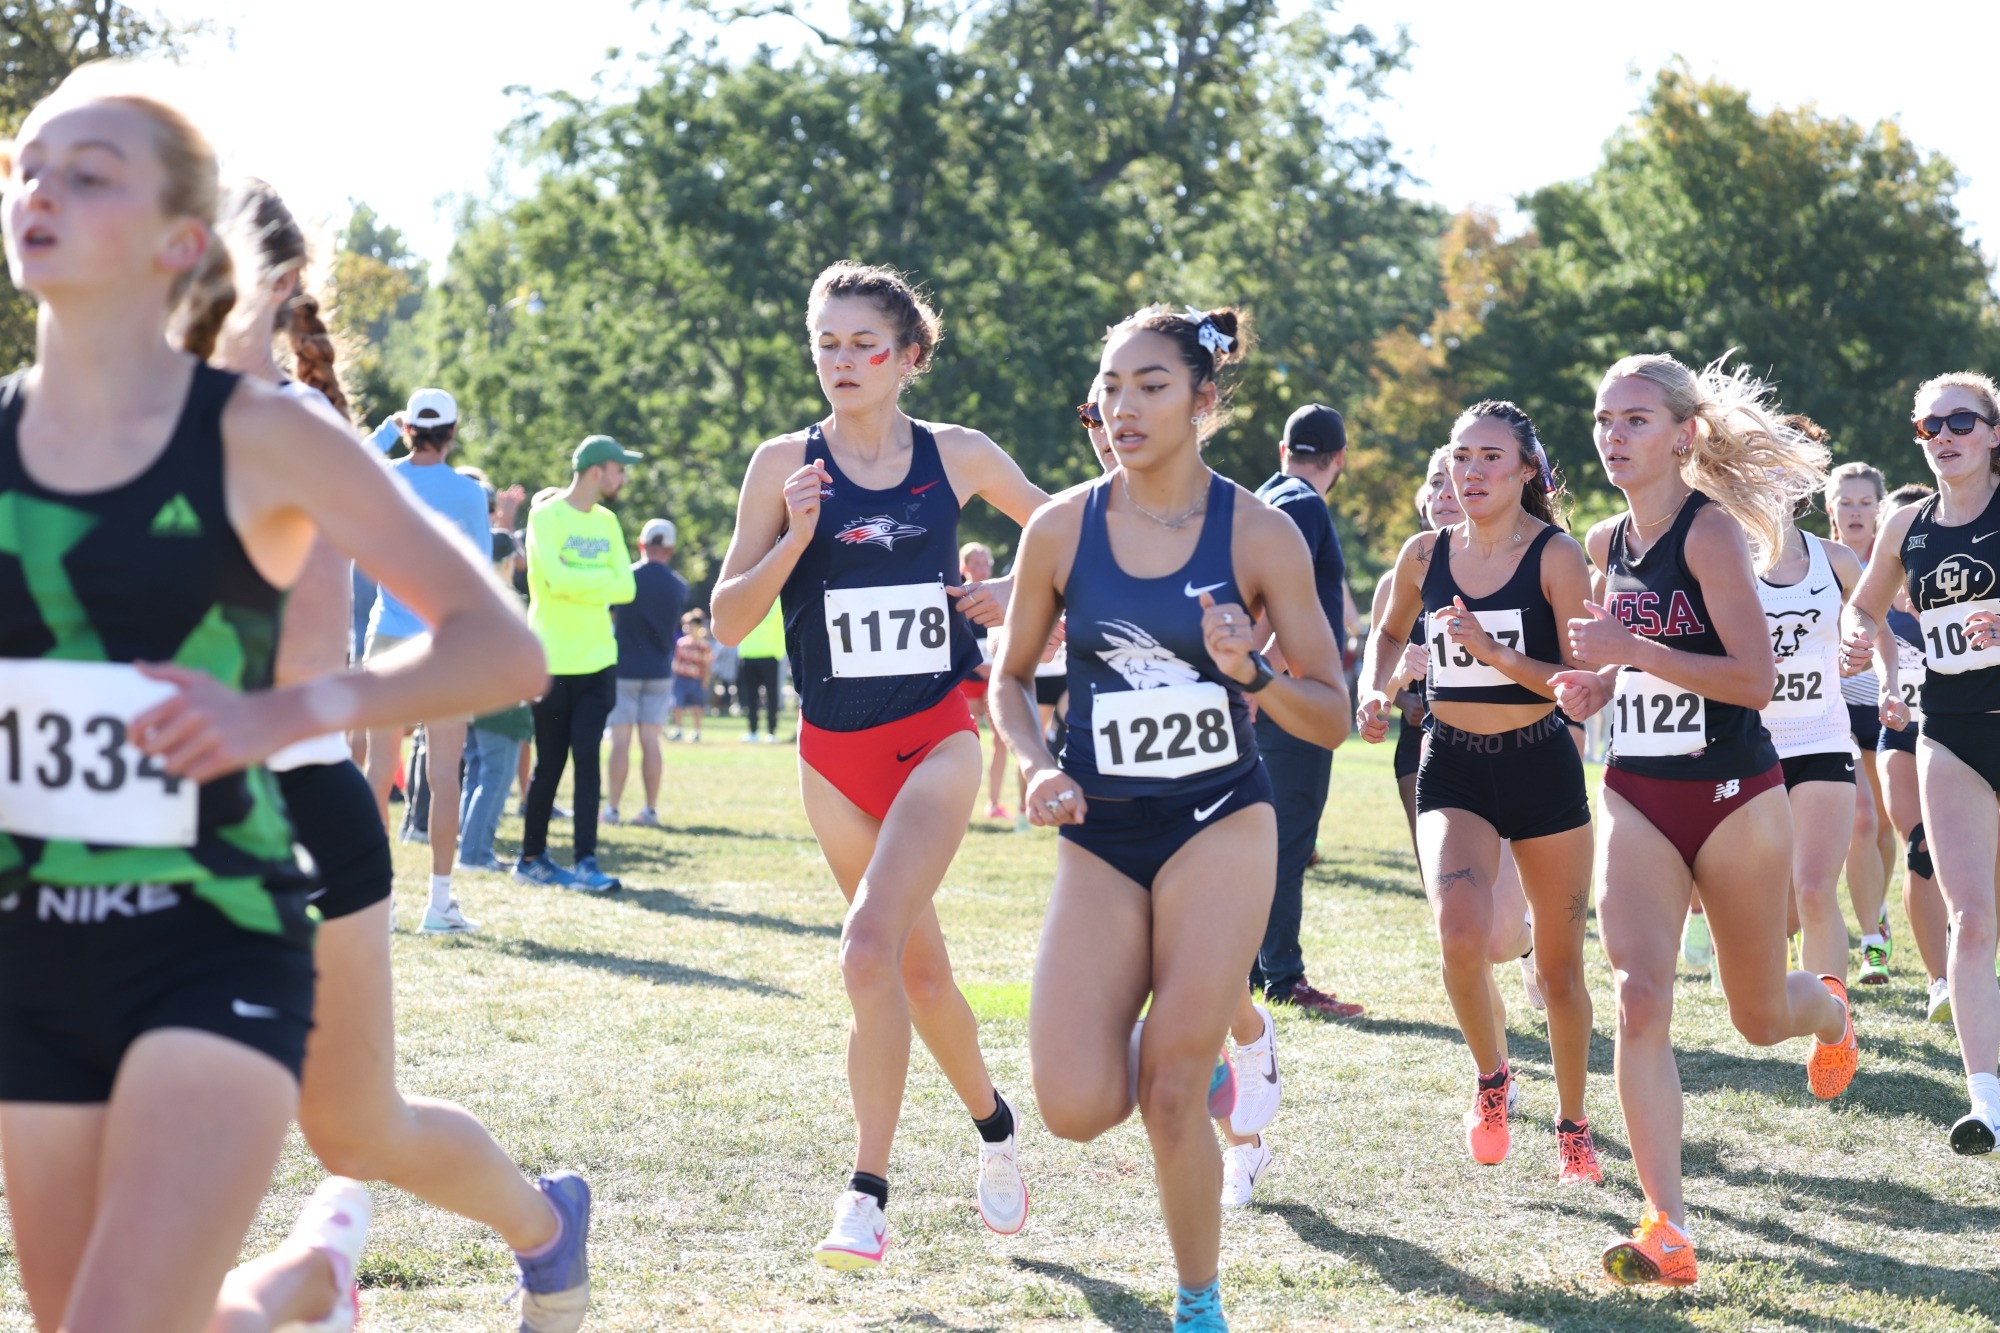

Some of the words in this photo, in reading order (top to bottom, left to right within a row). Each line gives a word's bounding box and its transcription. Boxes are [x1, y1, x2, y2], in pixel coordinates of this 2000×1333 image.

[1936, 561, 1970, 597] CU
[832, 606, 947, 653] 1178
[1432, 630, 1520, 667] 137
[1927, 617, 1990, 659] 10
[1771, 671, 1823, 701] 252
[1616, 692, 1702, 733] 1122
[1100, 708, 1230, 765] 1228
[1451, 727, 1504, 754] PRO
[37, 881, 181, 924] NIKE
